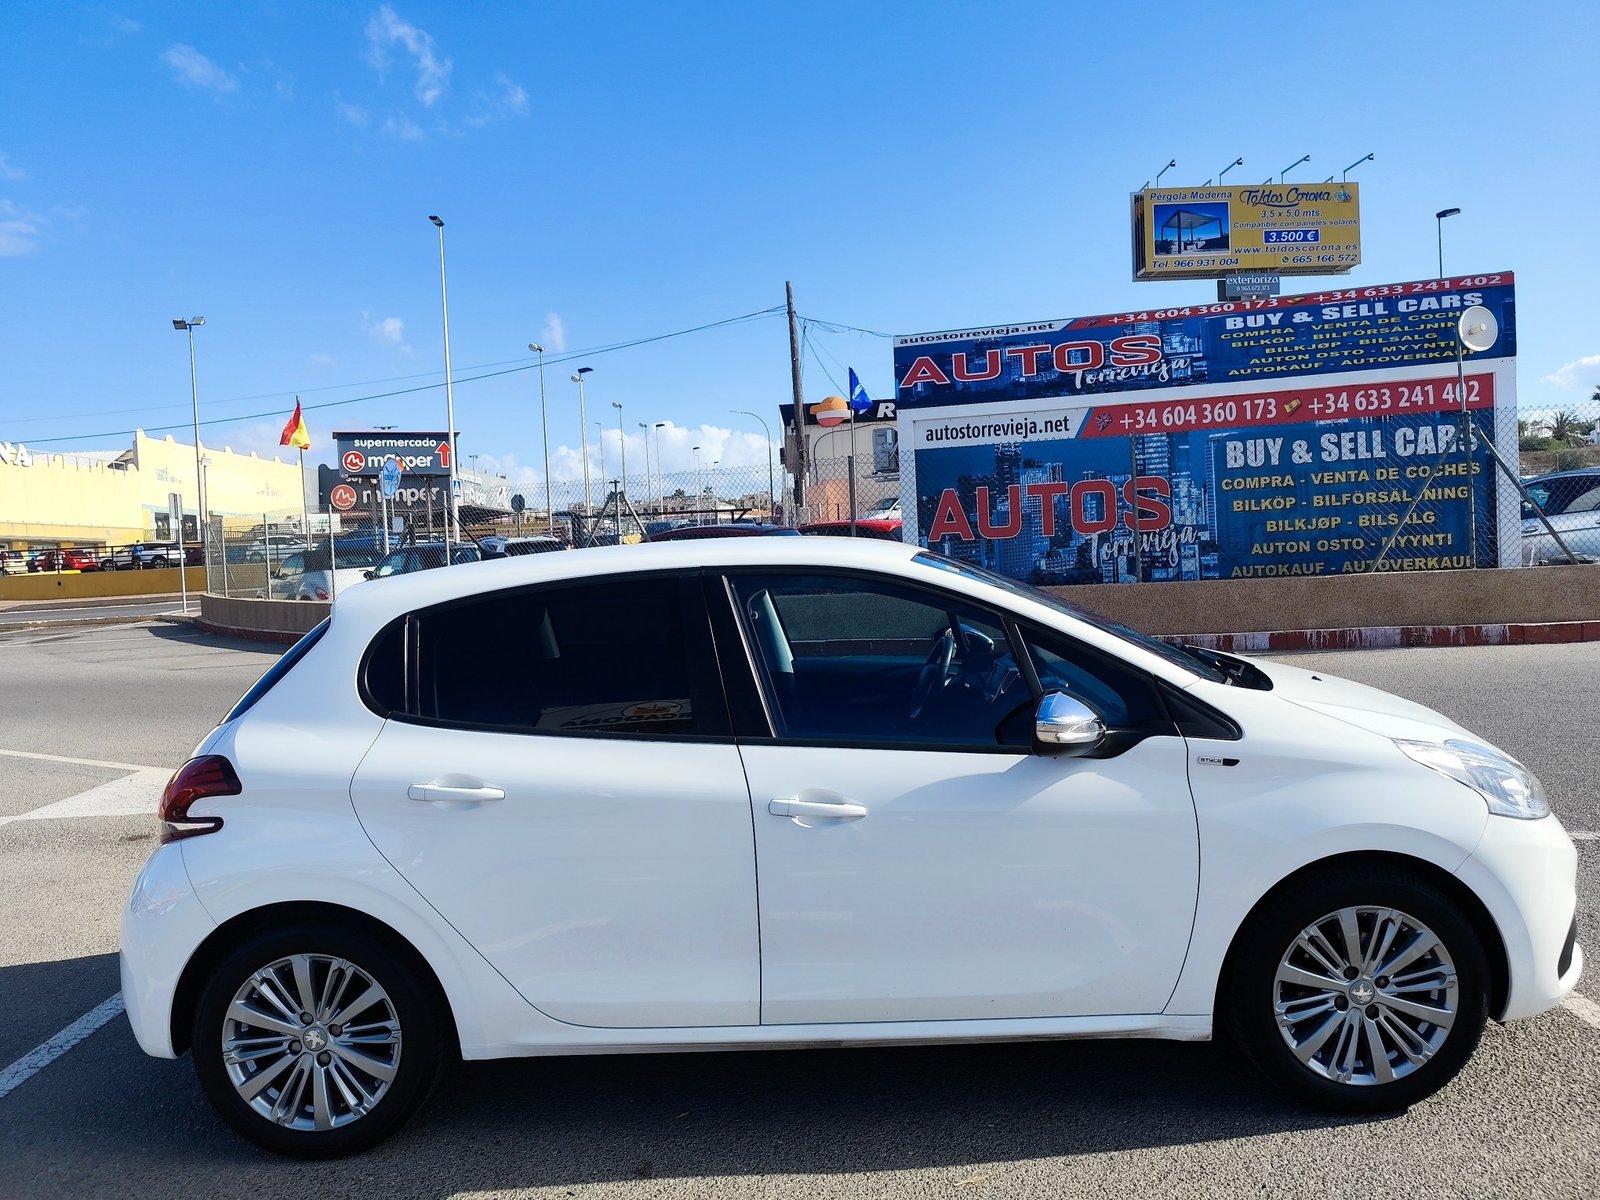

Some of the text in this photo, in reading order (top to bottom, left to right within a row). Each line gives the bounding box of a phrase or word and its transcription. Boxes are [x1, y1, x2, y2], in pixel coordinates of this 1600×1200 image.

[1190, 191, 1232, 199] Moderna
[1240, 187, 1331, 206] Toldos Corona
[1233, 219, 1278, 229] Compatible
[1296, 219, 1327, 228] paneles
[1261, 209, 1275, 219] 3,5
[1286, 209, 1300, 218] 5,0
[1268, 230, 1316, 242] 3.500 €
[1234, 244, 1358, 254] www.toldoscorona.es
[1292, 254, 1358, 264] 665 166 572
[1152, 257, 1239, 269] Tel. 966 931 004
[1226, 275, 1279, 285] exterioriza
[1313, 274, 1502, 302] +34 633 241 402
[1109, 298, 1279, 324] +34 604 360 173
[1225, 292, 1483, 330] BUY & SELL CARS
[899, 322, 1055, 345] autostorrevieja.net
[1220, 327, 1295, 340] COMPRA
[1311, 319, 1371, 331] VENTA
[1378, 317, 1401, 325] DE
[1408, 310, 1461, 321] COCH
[1231, 336, 1296, 348] BILKÖP
[1313, 321, 1457, 340] BILFÖRSÄLJNIN
[1249, 354, 1310, 365] AUTON
[1316, 349, 1365, 359] OSTO
[1382, 340, 1455, 353] MYYNTI
[1265, 341, 1342, 354] BILKJØP
[1359, 332, 1438, 345] BILSALG
[899, 334, 1163, 388] AUTOS
[1228, 361, 1324, 376] AUTOKAUF
[1069, 358, 1191, 390] Torrevieja
[1308, 380, 1480, 415] +34 633 241 402
[1119, 398, 1277, 430] +34 604 360 173
[925, 416, 1070, 443] autostorrevieja.net
[354, 437, 437, 449] supermercado
[1226, 437, 1284, 469] BUY
[1292, 439, 1313, 464] &
[1320, 430, 1387, 462] SELL
[1221, 474, 1295, 491] COMPRA
[1310, 469, 1370, 485] VENTA
[1376, 467, 1399, 481] DE
[928, 475, 1171, 542] AUTOS
[1233, 495, 1296, 512] BILKÖP
[1313, 486, 1468, 507] BILFÖRSÄLNING
[1266, 516, 1342, 533] BILKJØP
[1085, 523, 1198, 569] Torrvieja
[1251, 540, 1311, 555] AUTON
[1316, 537, 1365, 551] OSTO
[1231, 562, 1325, 578] AUTOKAUF
